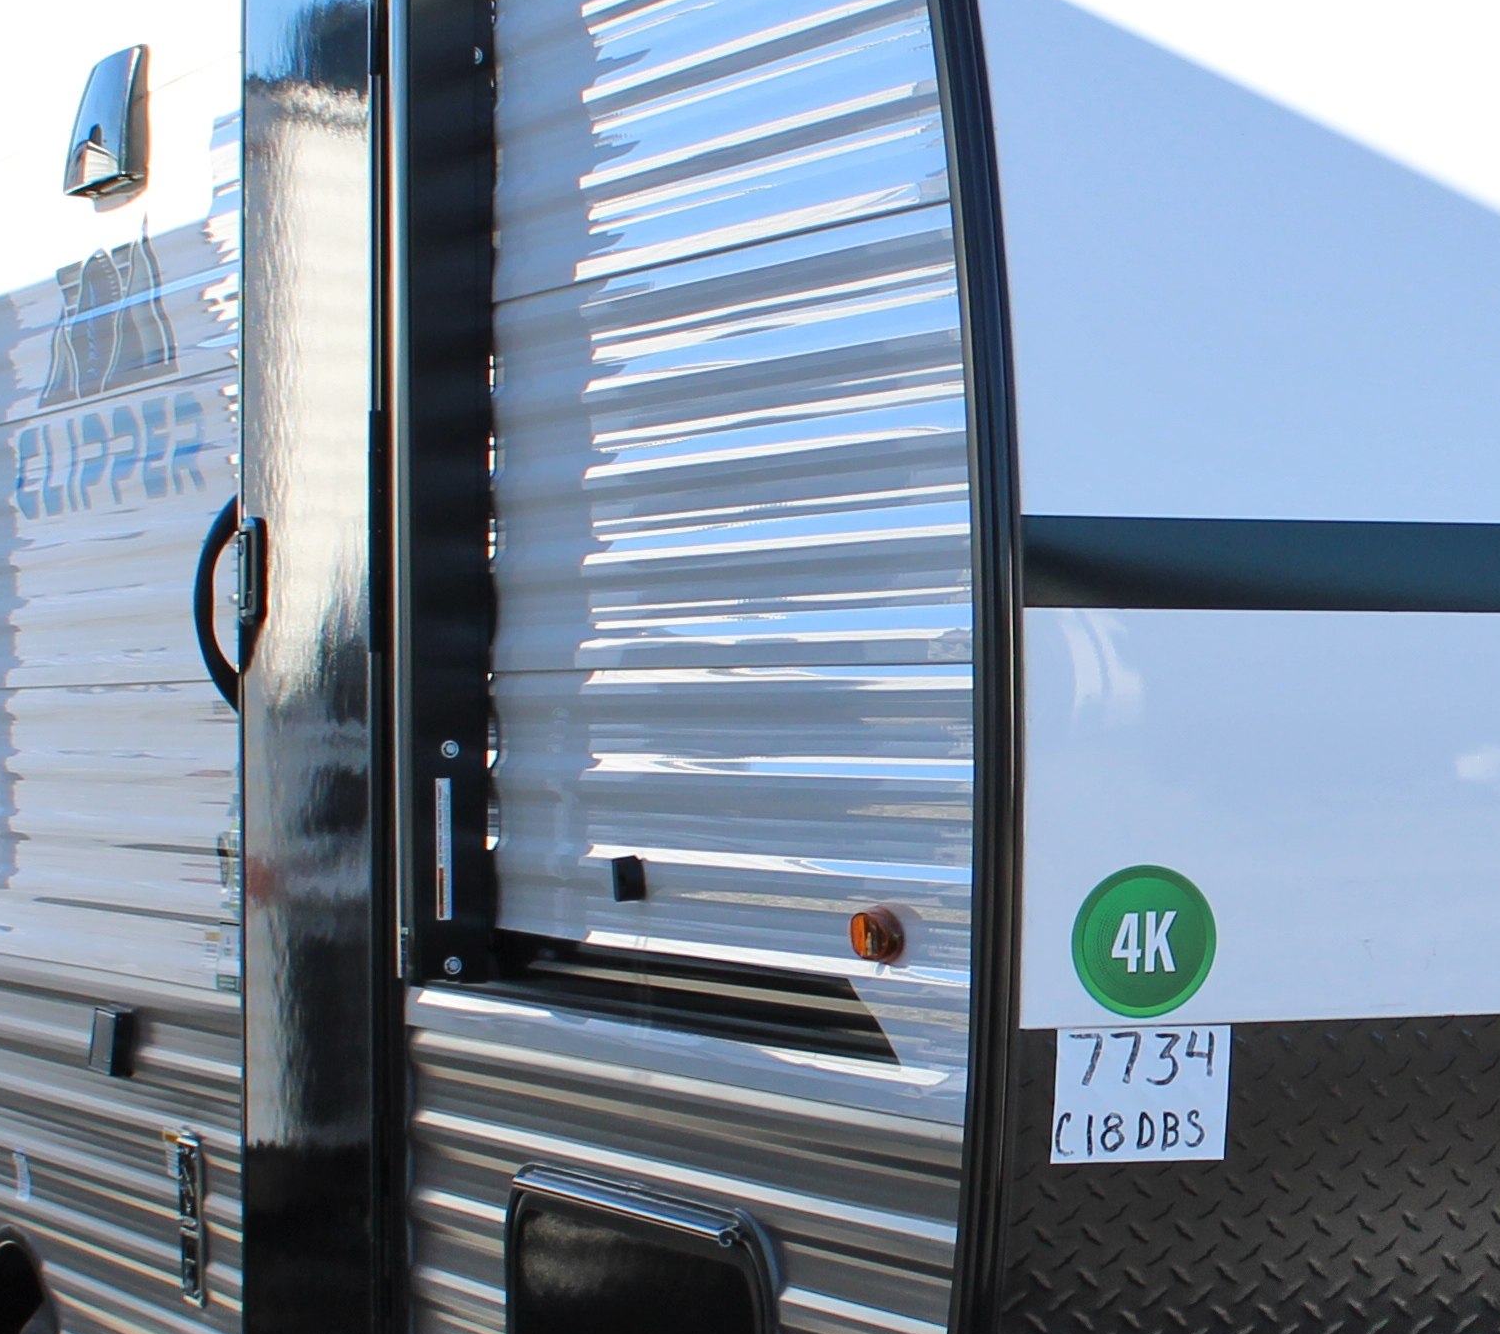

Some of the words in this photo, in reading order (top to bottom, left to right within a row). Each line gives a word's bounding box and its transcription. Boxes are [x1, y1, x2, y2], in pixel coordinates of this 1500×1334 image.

[15, 390, 207, 521] CLIPPER
[1111, 910, 1177, 973] 4K
[1069, 1030, 1215, 1086] 7734
[1055, 1109, 1205, 1156] C18DBS
